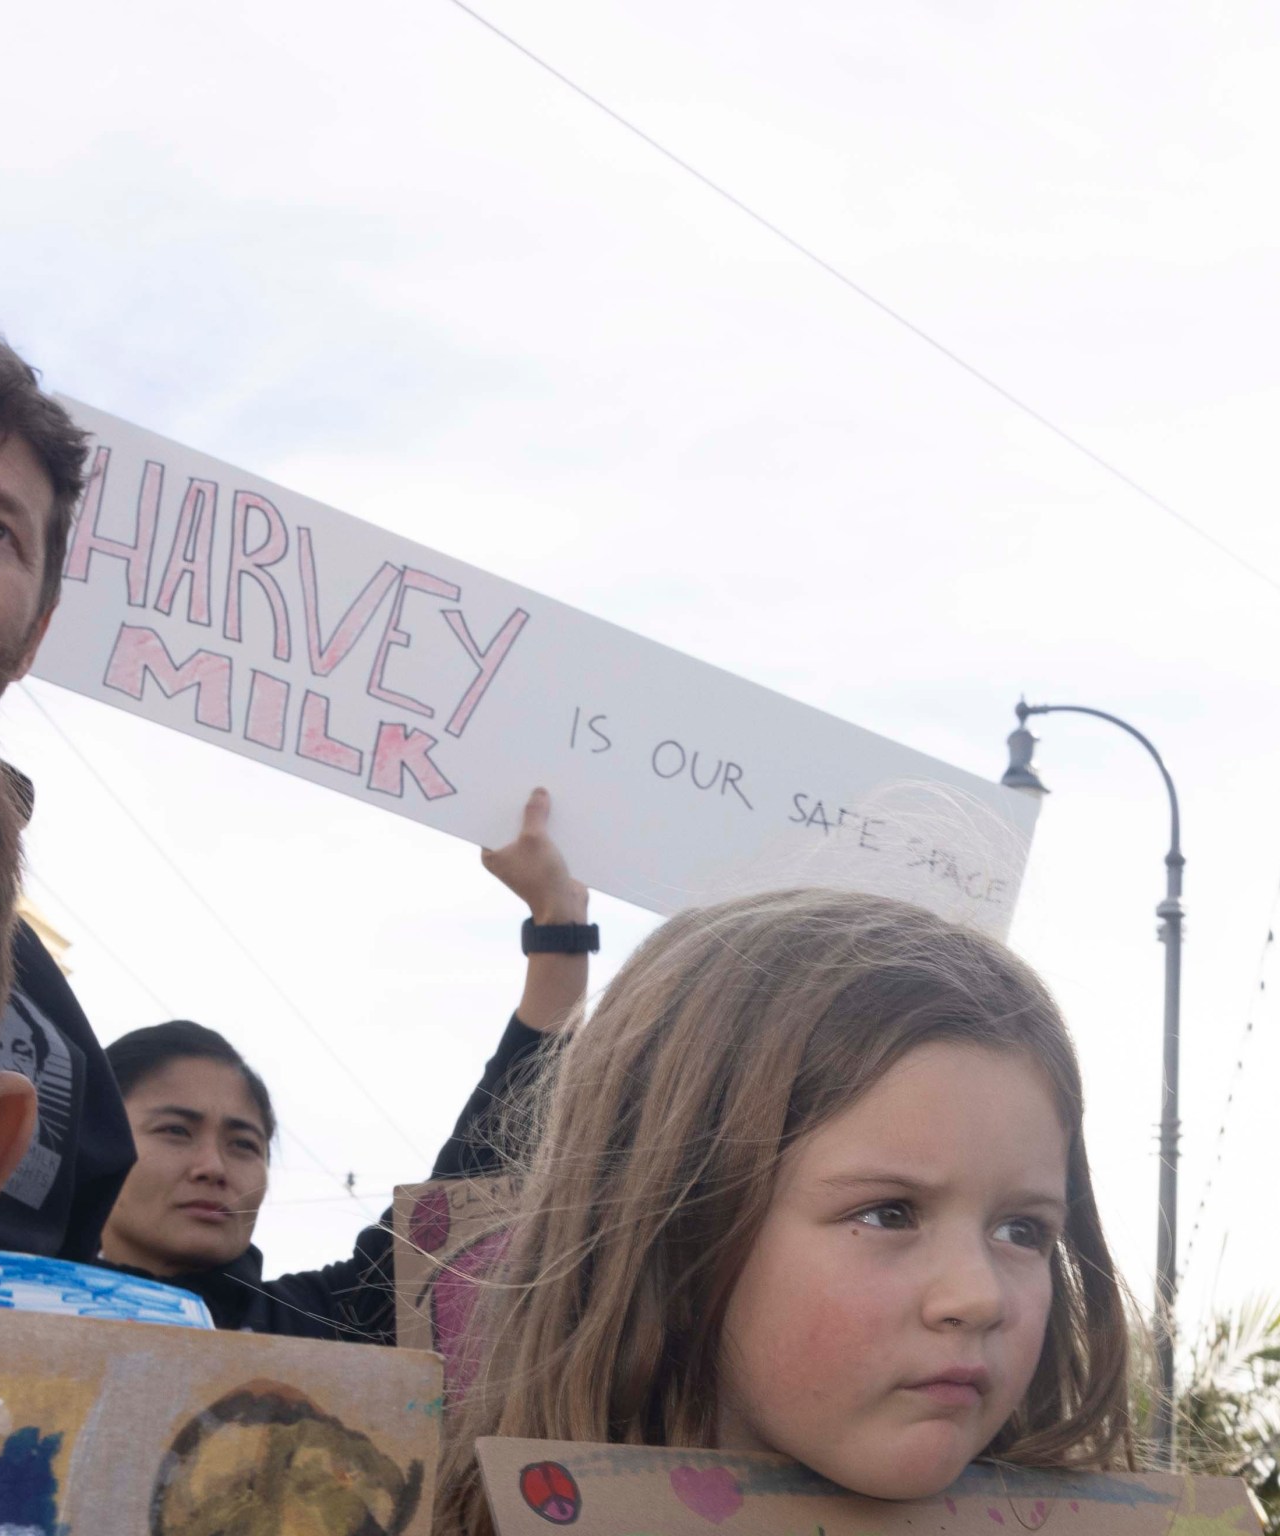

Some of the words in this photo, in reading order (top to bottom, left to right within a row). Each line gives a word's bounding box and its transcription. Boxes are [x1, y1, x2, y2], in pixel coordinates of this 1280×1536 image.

[61, 446, 530, 738] HARVEY
[104, 622, 458, 801] MILK
[568, 704, 612, 756] IS
[651, 738, 754, 810] OUR
[787, 792, 884, 852] SAFE
